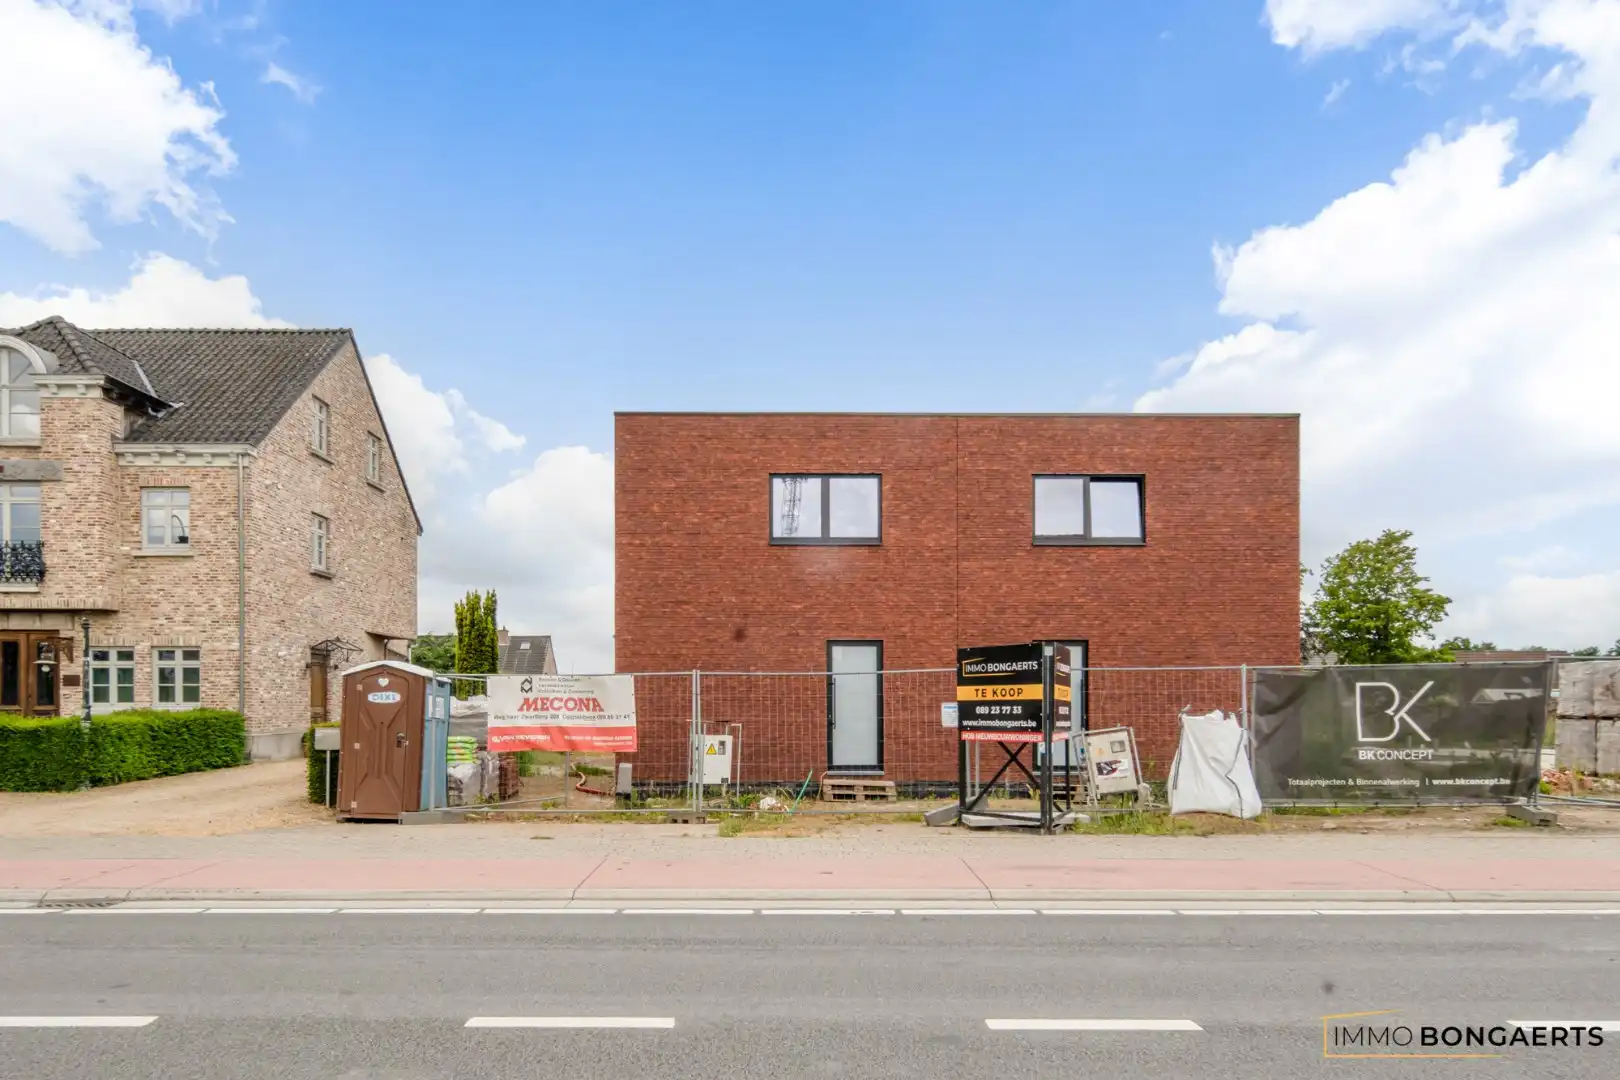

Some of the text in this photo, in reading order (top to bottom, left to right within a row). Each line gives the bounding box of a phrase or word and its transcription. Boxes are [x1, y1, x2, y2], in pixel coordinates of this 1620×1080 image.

[965, 661, 1038, 673] IMMO BONGAERTS
[371, 693, 397, 701] DIXI
[974, 687, 1024, 698] TE KOOP
[517, 697, 605, 712] MECONA
[975, 705, 1022, 714] 089 23 77 33
[962, 718, 1037, 728] www.immobongaerts.be
[1287, 778, 1346, 788] Totaalprojecten
